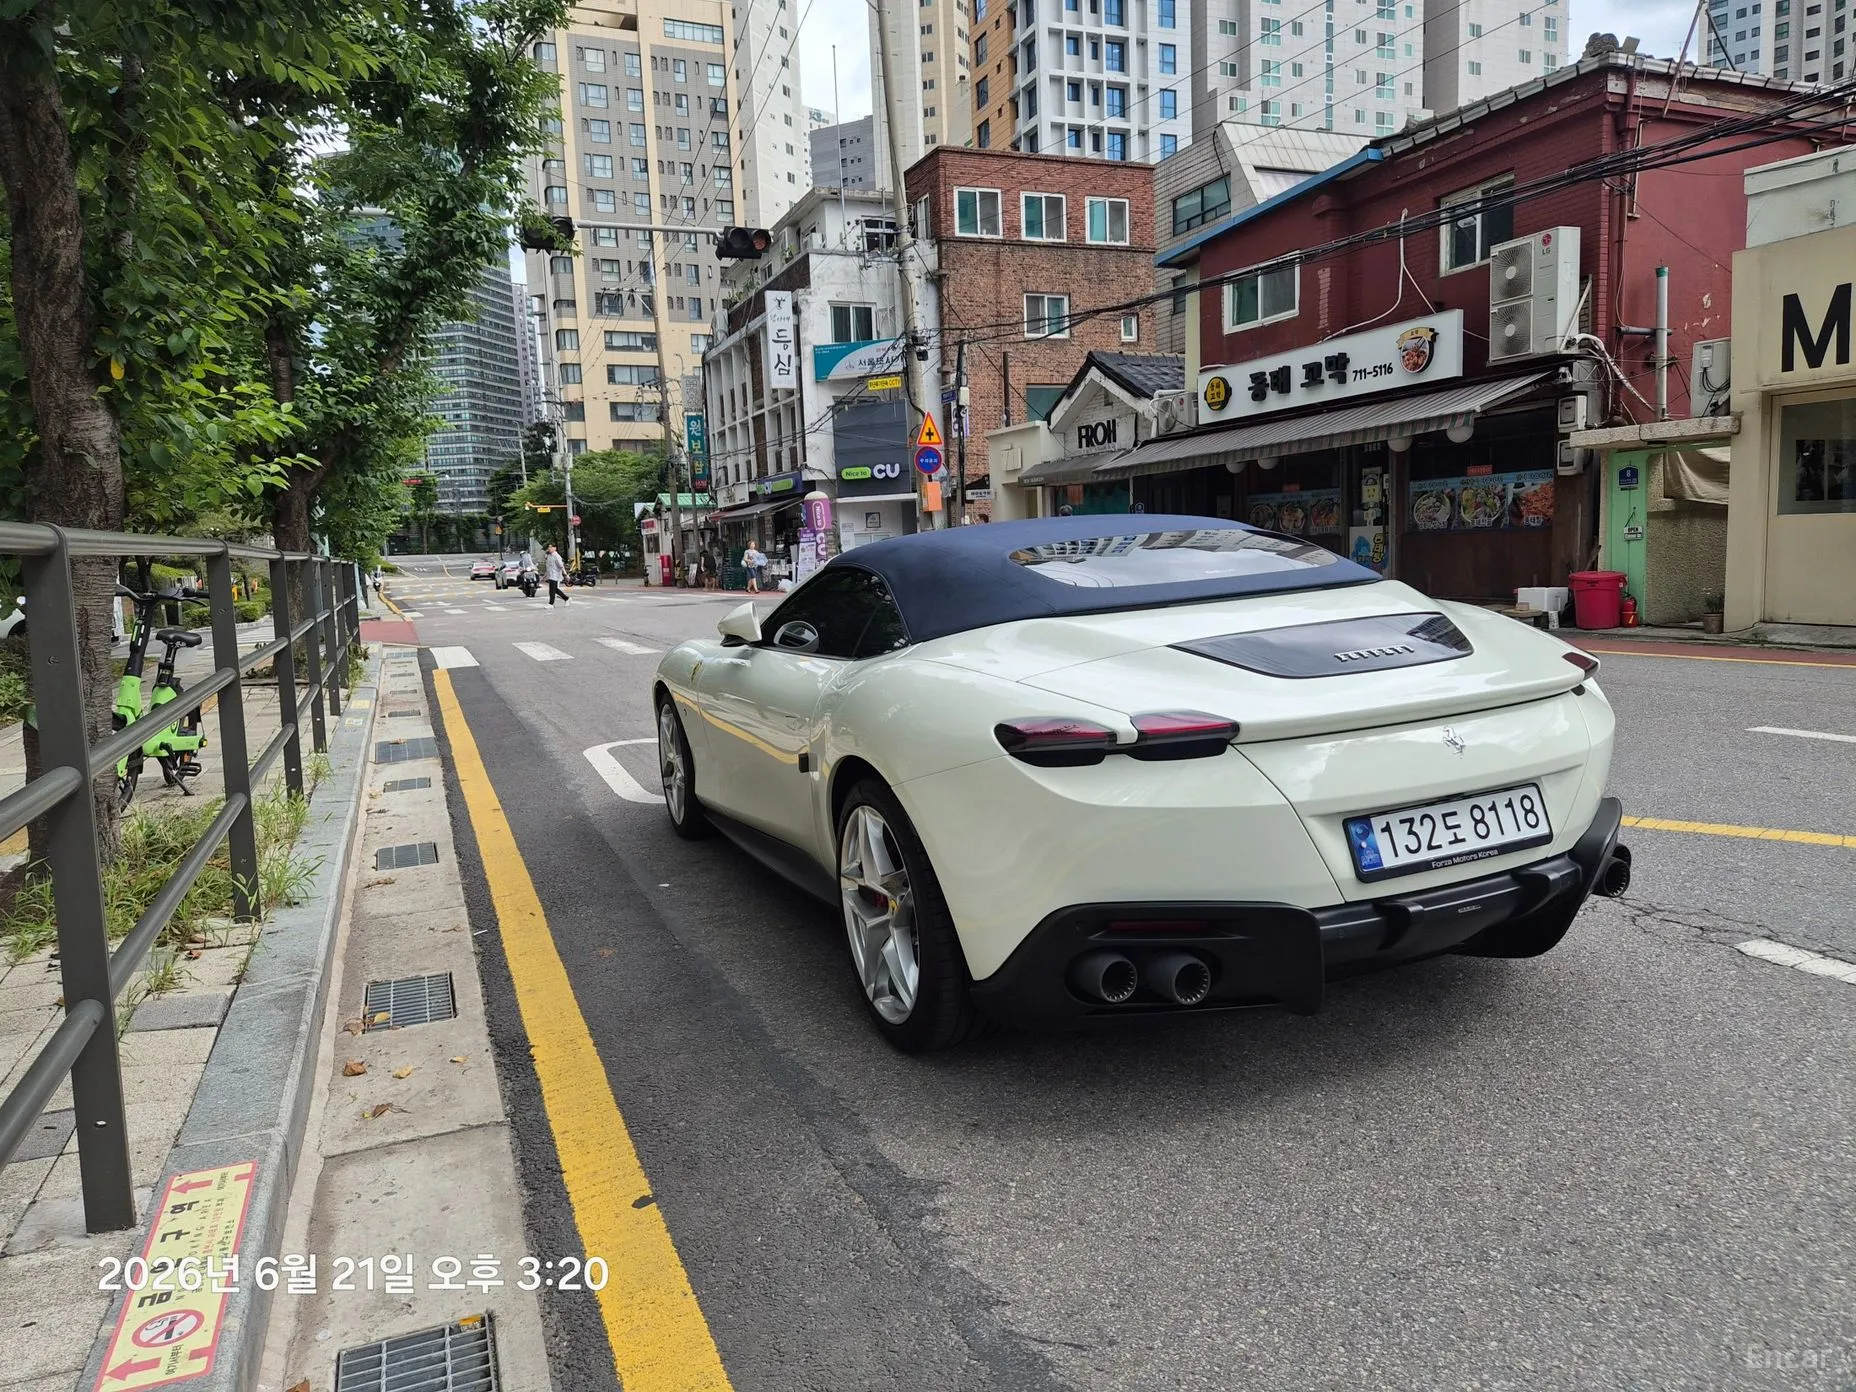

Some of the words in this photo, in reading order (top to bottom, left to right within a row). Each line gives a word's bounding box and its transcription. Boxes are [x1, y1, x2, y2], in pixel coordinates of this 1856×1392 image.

[1781, 282, 1852, 372] M
[772, 329, 792, 375] 등심
[1248, 365, 1291, 401] 동태
[1300, 352, 1350, 388] 꼬막
[1352, 362, 1393, 381] 711-5116
[873, 463, 900, 479] CU
[1626, 469, 1631, 477] 8
[816, 532, 827, 556] CU
[1334, 644, 1415, 662] Ferrari
[1381, 811, 1467, 857] 132도
[1470, 794, 1540, 839] 8118
[1432, 857, 1453, 868] Forza
[1453, 854, 1478, 865] Motors
[1479, 849, 1499, 860] Korea
[164, 1343, 184, 1375] 여기서부터
